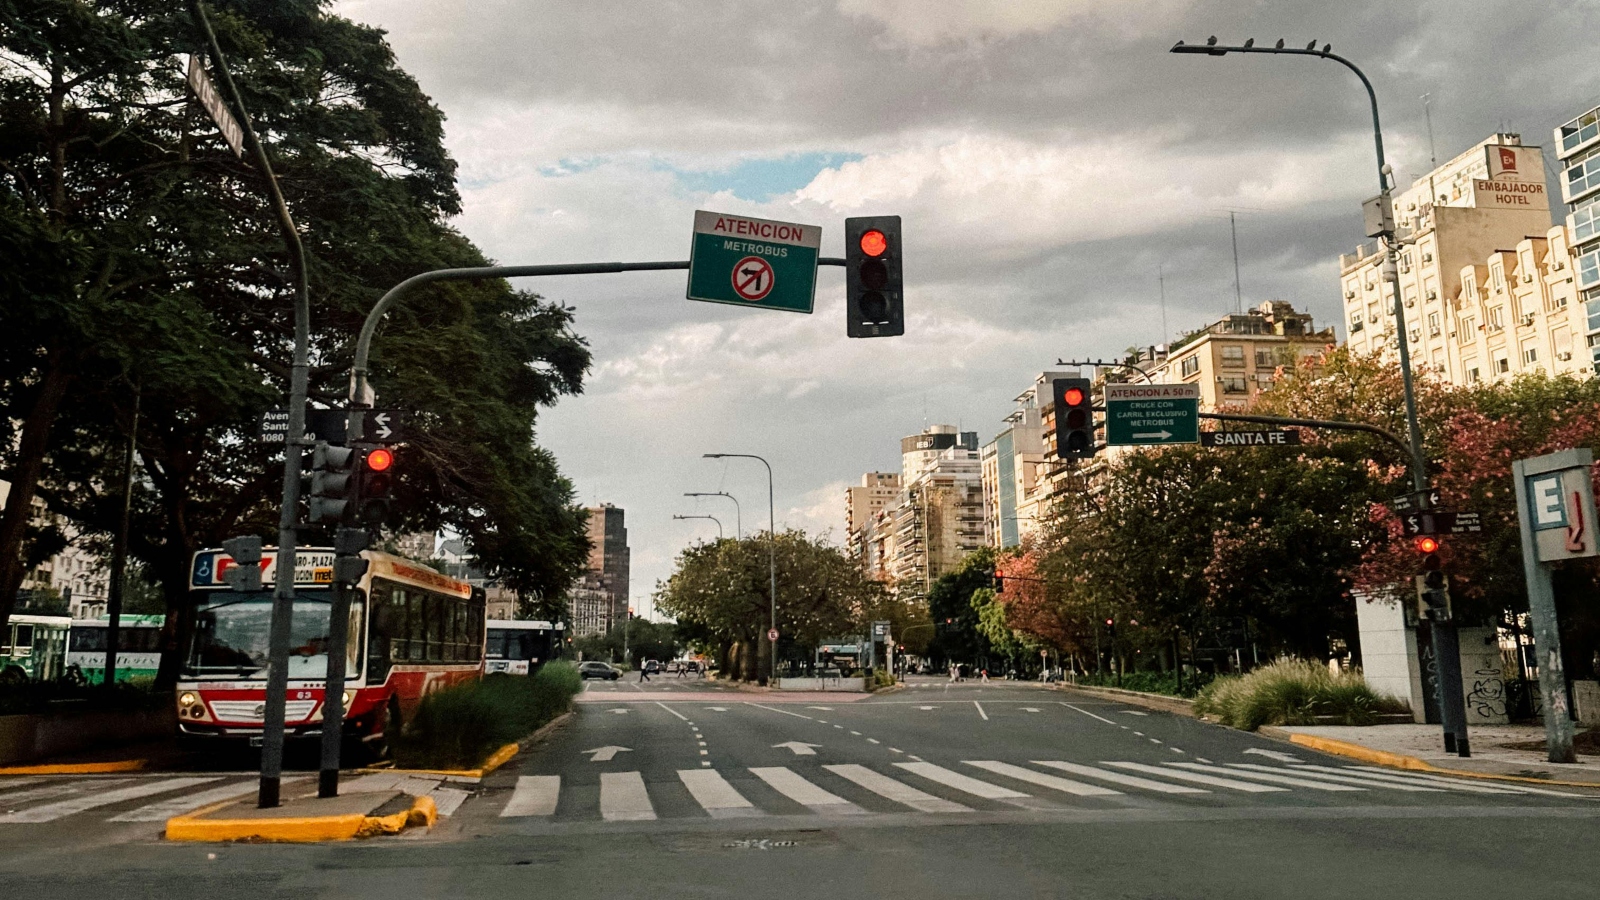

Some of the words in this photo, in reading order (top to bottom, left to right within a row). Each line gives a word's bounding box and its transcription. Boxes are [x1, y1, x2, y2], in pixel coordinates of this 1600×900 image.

[1478, 182, 1544, 194] EMBAJADOR
[1496, 194, 1530, 205] HOTEL
[714, 217, 803, 242] ATENCION
[723, 240, 788, 258] METROBUS
[1110, 388, 1160, 398] ATENCION
[1162, 388, 1170, 396] A
[1172, 388, 1184, 396] 50
[263, 411, 289, 420] Aven
[1145, 410, 1188, 418] EXCLUSIVO
[261, 433, 285, 442] 1080
[1214, 432, 1264, 445] SANTA
[1268, 432, 1286, 444] FE
[1533, 477, 1562, 524] E
